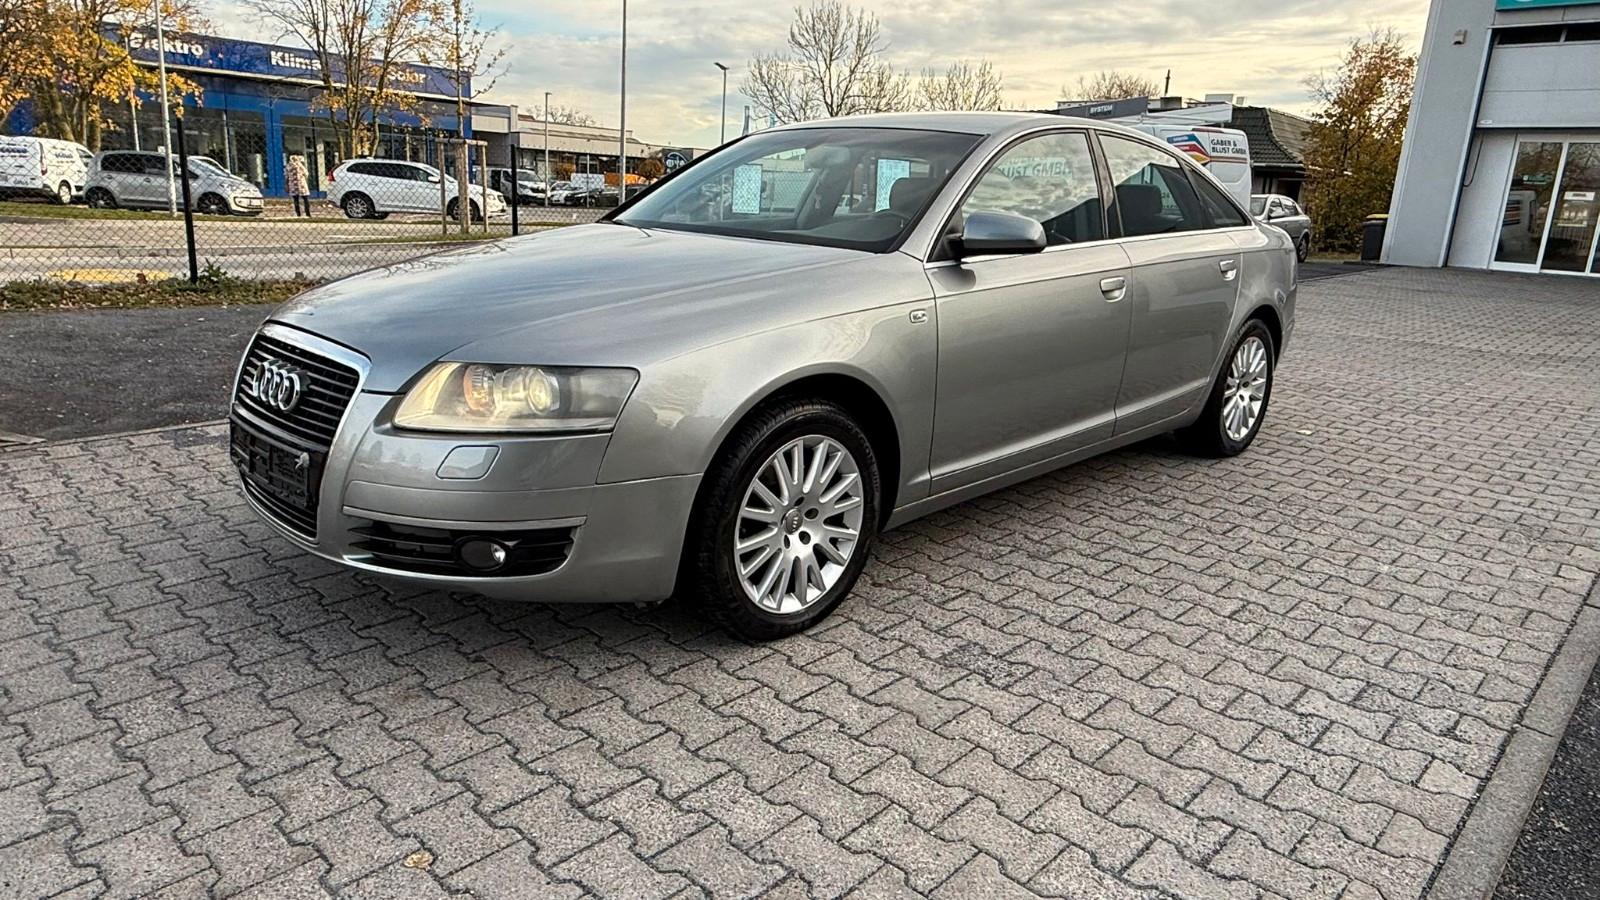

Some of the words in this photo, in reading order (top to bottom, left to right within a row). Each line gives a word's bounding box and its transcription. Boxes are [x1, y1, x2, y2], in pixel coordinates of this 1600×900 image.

[270, 50, 321, 71] Klima
[1210, 138, 1231, 147] GABER
[1211, 146, 1230, 154] BLUST
